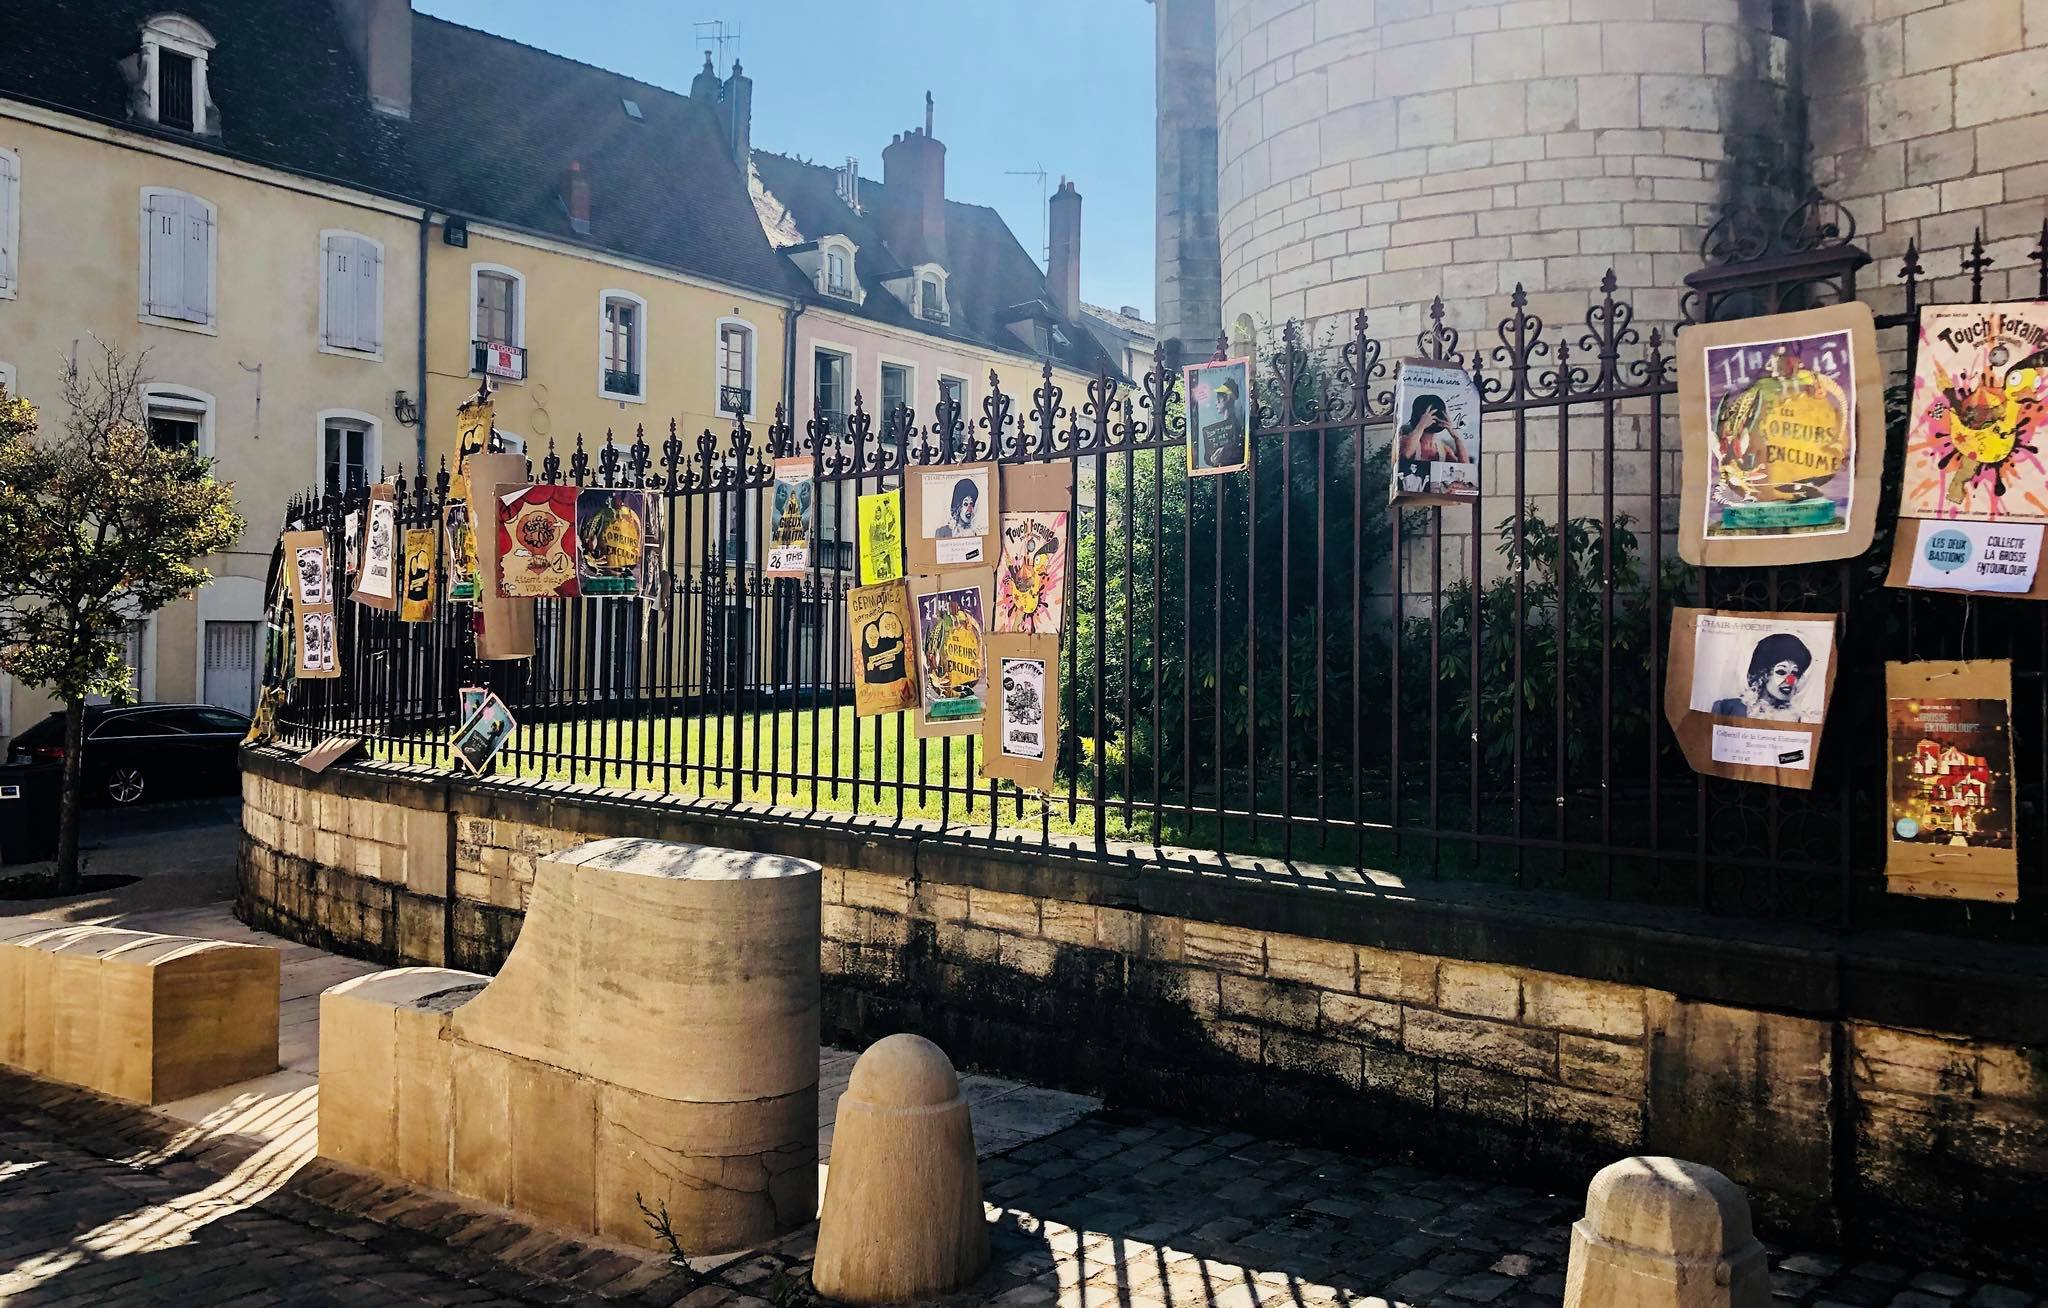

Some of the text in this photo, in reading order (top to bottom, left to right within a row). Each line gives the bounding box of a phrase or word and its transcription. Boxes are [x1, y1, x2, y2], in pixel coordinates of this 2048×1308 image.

[498, 345, 521, 355] LOUER
[1932, 538, 1968, 550] LES DEUX
[1987, 536, 2026, 549] COLLECTIF
[770, 555, 782, 569] 26
[1928, 550, 1966, 564] BASTIONS
[1984, 549, 2027, 563] LA GROSSE
[1976, 562, 2029, 576] ENTOURLOUPE
